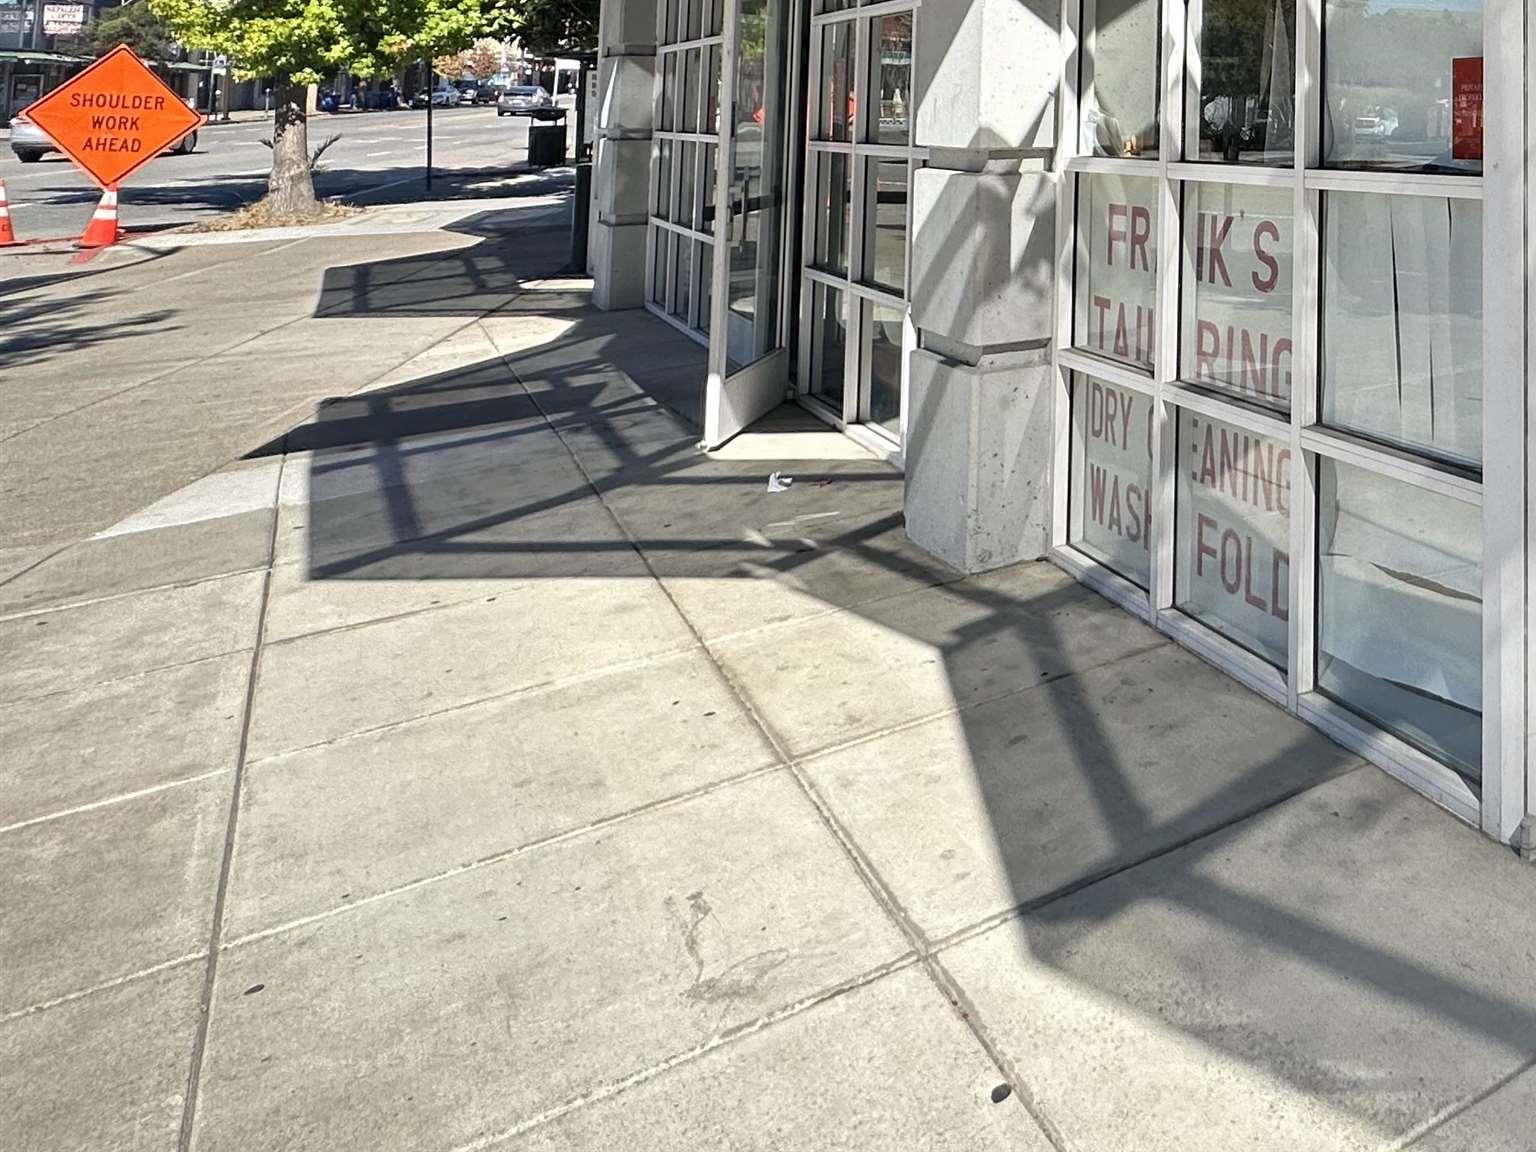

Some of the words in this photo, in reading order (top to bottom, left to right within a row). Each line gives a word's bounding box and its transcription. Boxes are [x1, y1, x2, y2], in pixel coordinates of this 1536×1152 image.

[69, 93, 165, 110] SHOULDER
[91, 116, 140, 131] WORK
[82, 137, 142, 153] AHEAD
[1094, 295, 1292, 398] TAILRING
[1092, 383, 1133, 450] DRY
[1196, 513, 1290, 623] FOLD
